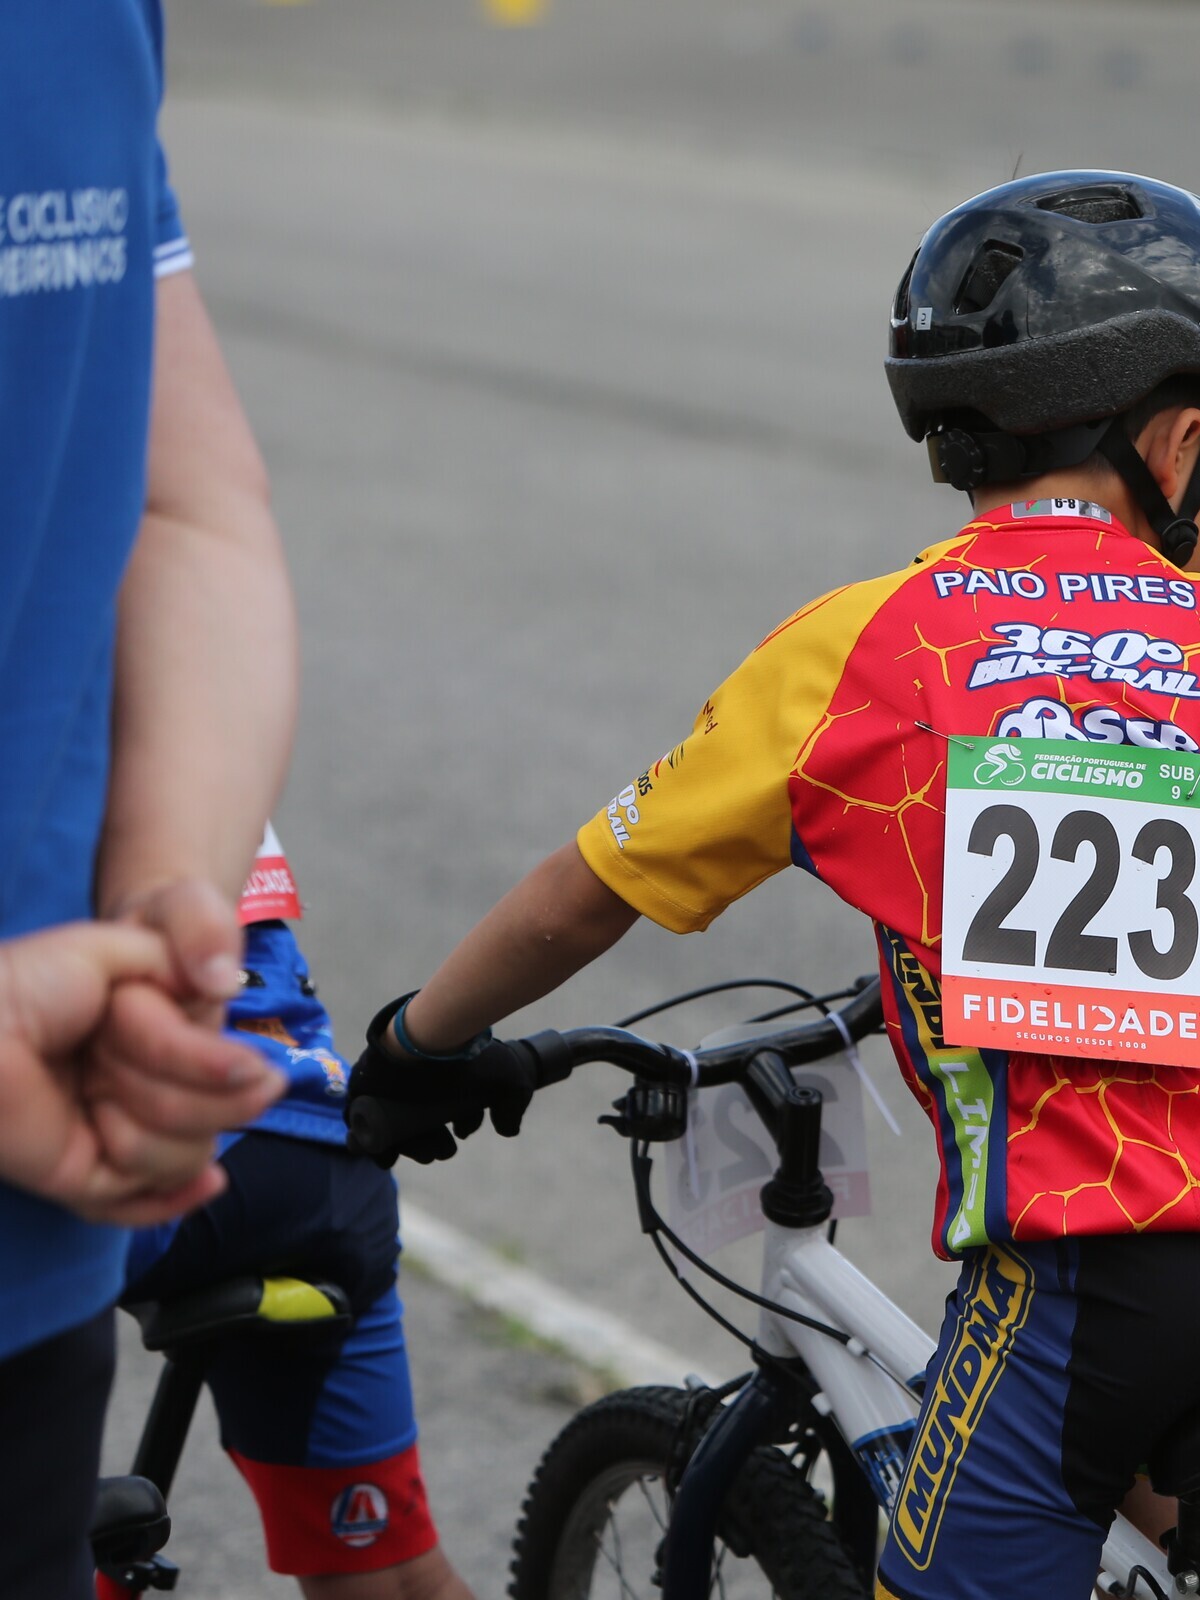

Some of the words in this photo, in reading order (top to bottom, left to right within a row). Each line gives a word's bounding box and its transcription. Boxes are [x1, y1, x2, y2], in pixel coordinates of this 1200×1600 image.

[933, 569, 1047, 600] PAIO
[1056, 572, 1197, 609] PIRES
[1034, 753, 1082, 764] FEDERAÇÃO
[1083, 758, 1135, 769] PORTUGUESA
[1136, 763, 1147, 771] DE
[1159, 764, 1195, 782] SUB
[1031, 762, 1144, 789] CICLISMO
[1171, 785, 1181, 800] 9
[962, 804, 1199, 980] 223
[963, 994, 1198, 1040] FIDELIDADE
[1016, 1031, 1071, 1043] SEGUROS
[1076, 1037, 1113, 1047] DESDE
[1119, 1041, 1147, 1050] 1808
